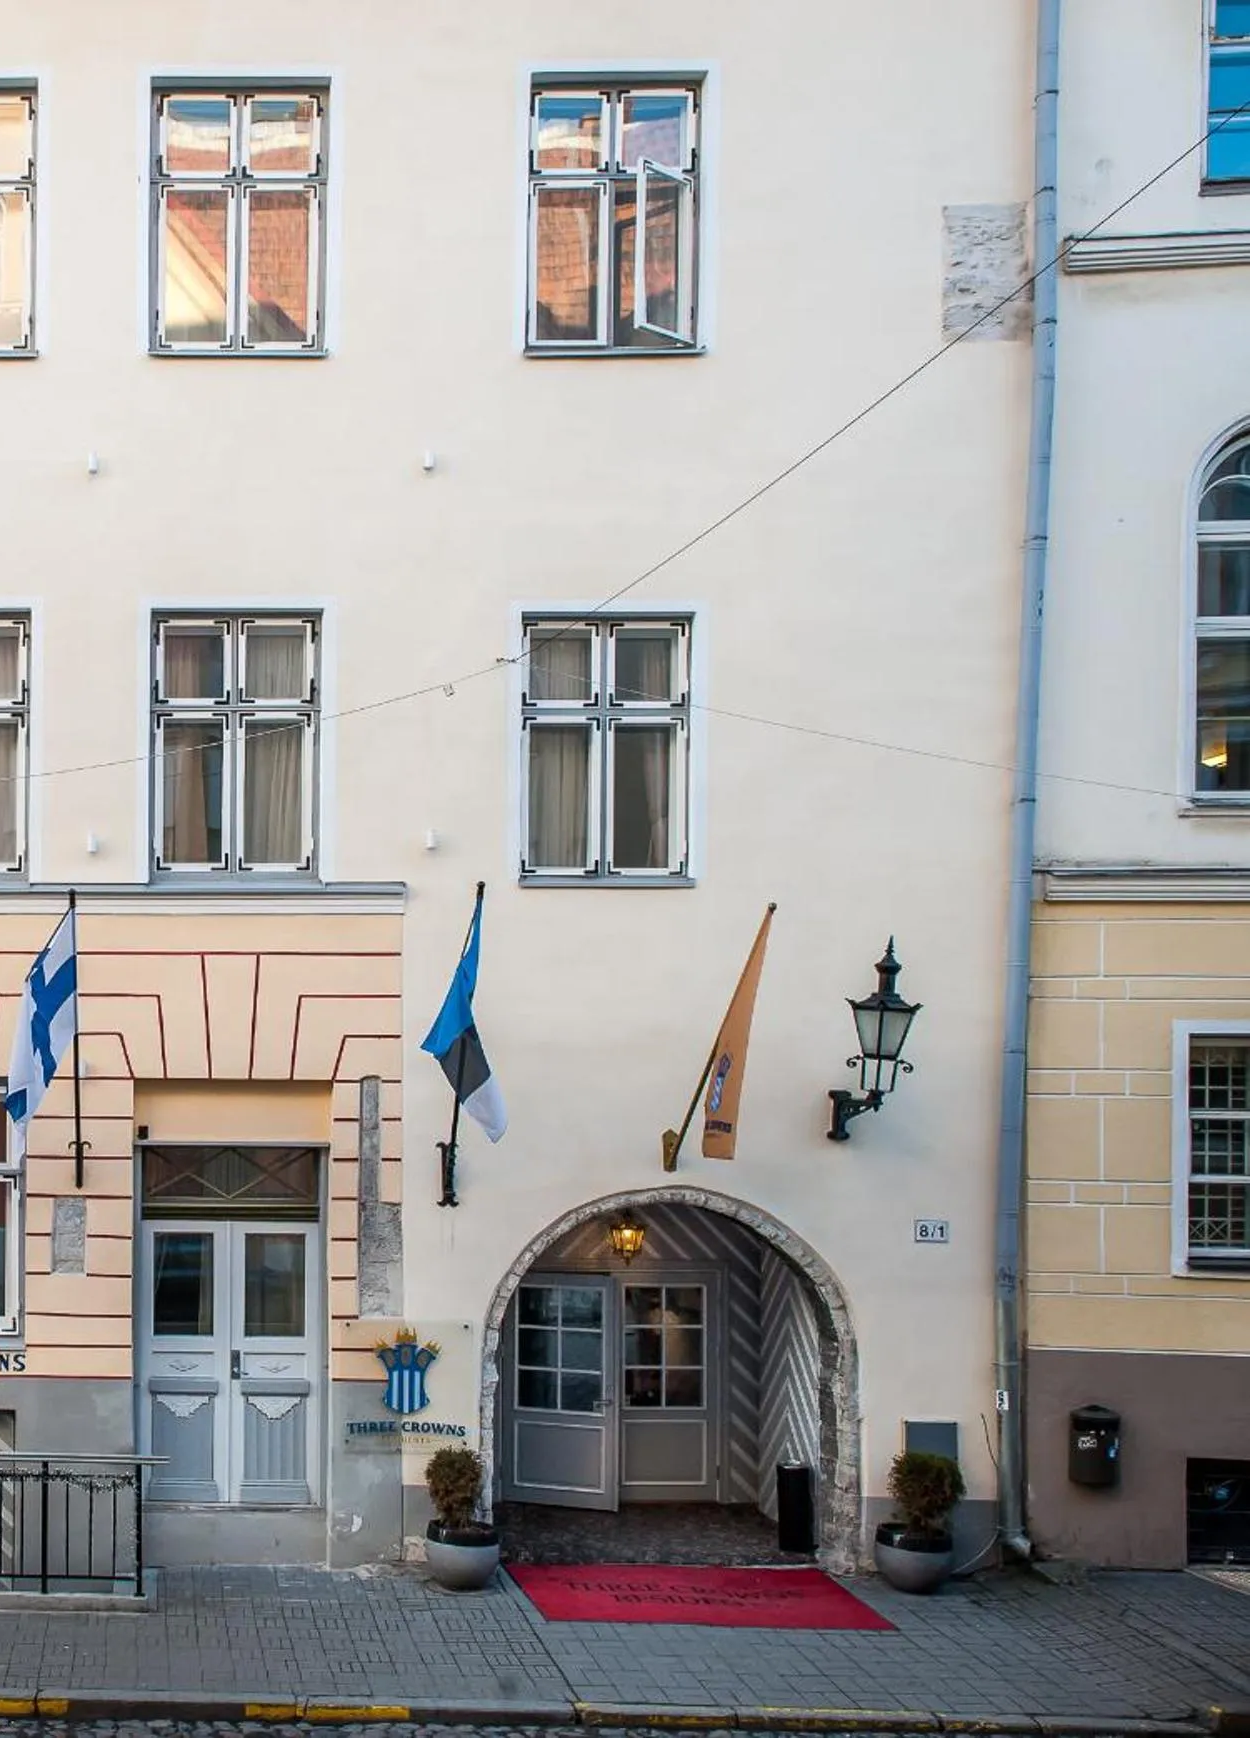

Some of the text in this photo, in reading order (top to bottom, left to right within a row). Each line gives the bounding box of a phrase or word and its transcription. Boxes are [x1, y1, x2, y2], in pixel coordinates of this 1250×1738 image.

[919, 1224, 945, 1238] 8/1
[347, 1421, 466, 1437] THREE CROWNS
